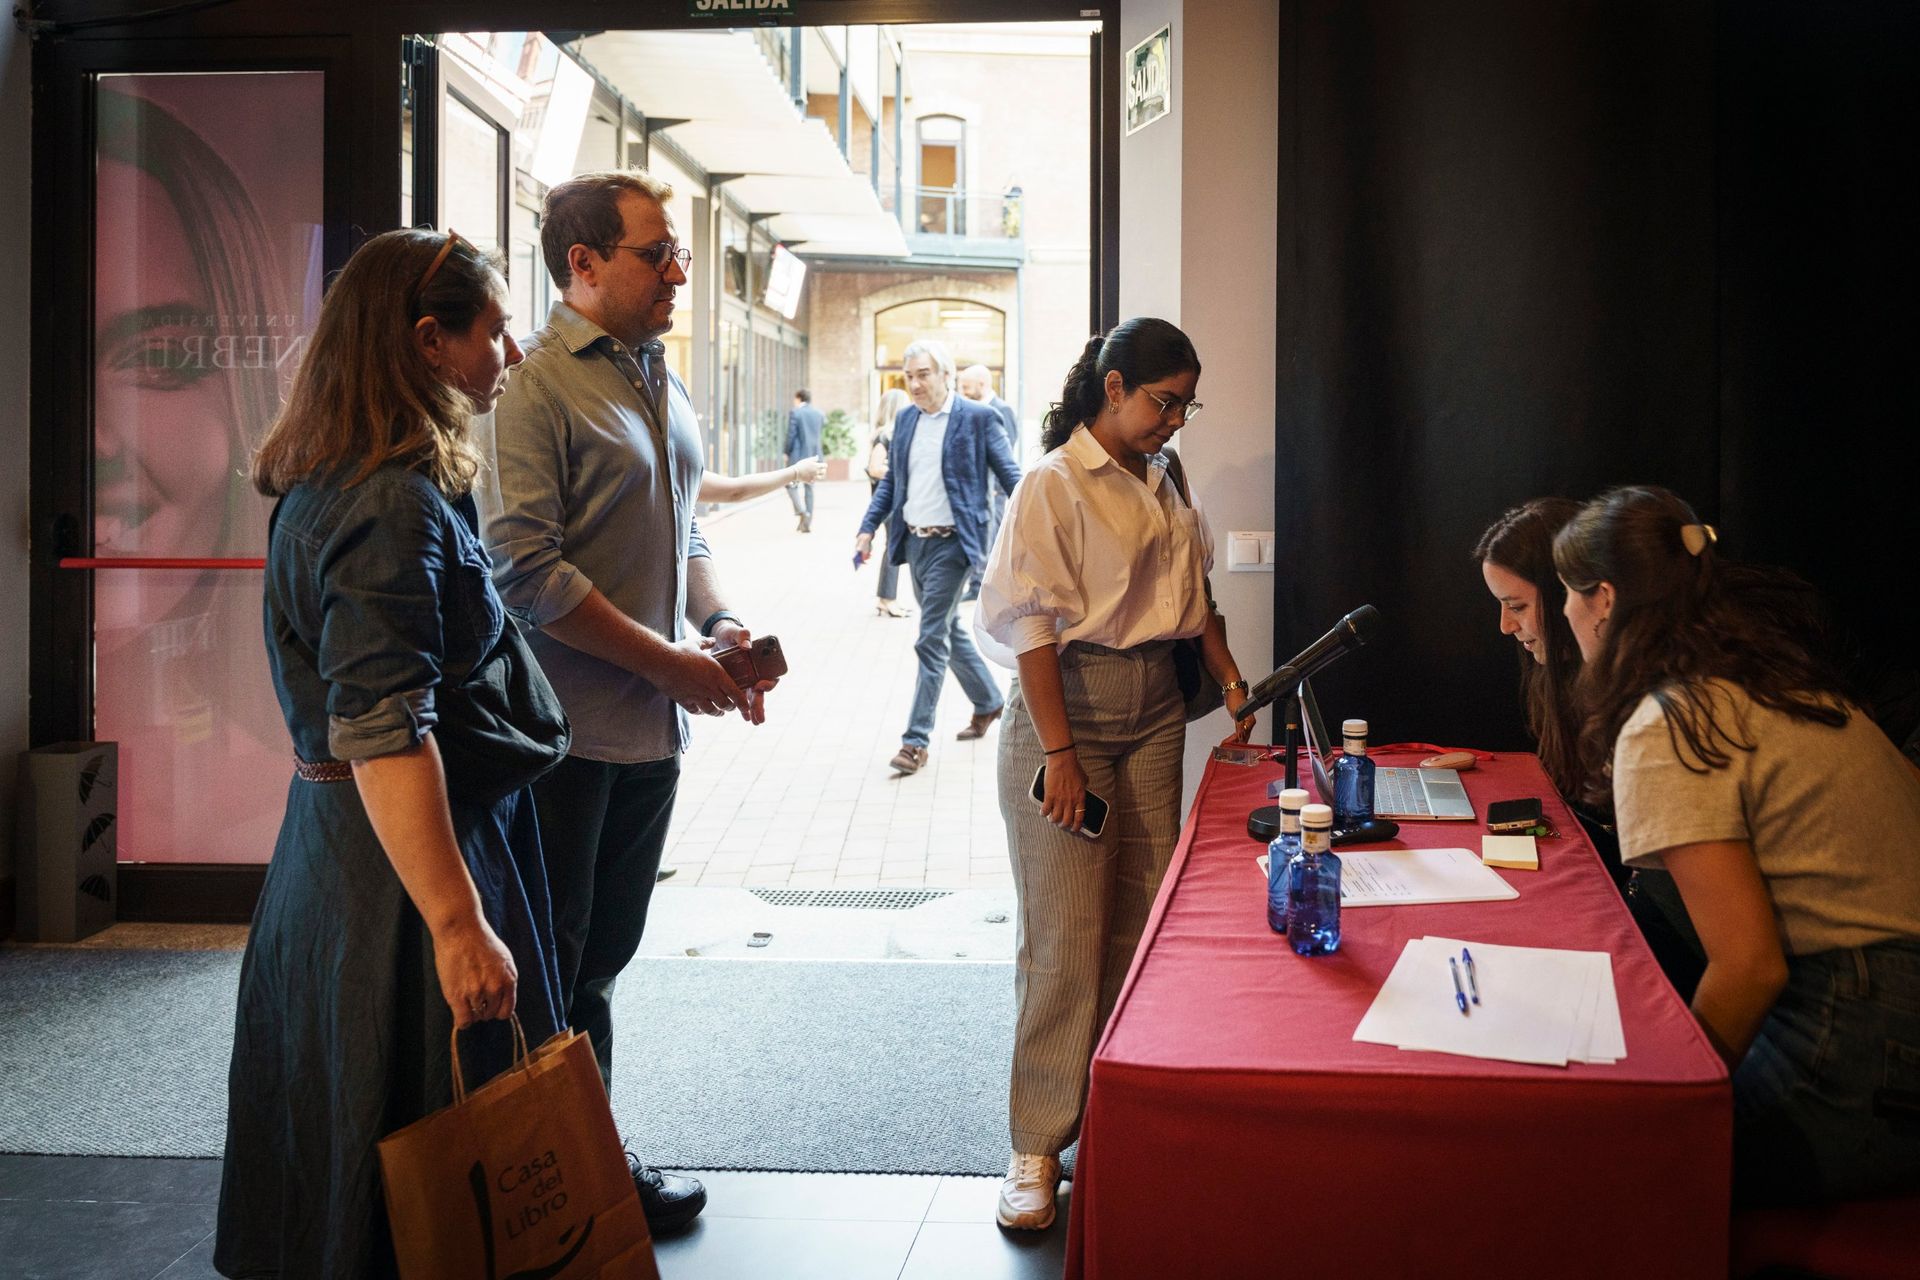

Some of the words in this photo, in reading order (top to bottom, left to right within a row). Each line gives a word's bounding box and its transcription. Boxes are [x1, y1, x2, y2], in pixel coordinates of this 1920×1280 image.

[1129, 58, 1168, 109] SALIDA
[498, 1150, 557, 1193] Casa
[532, 1168, 564, 1198] del
[506, 1192, 568, 1239] Libro
